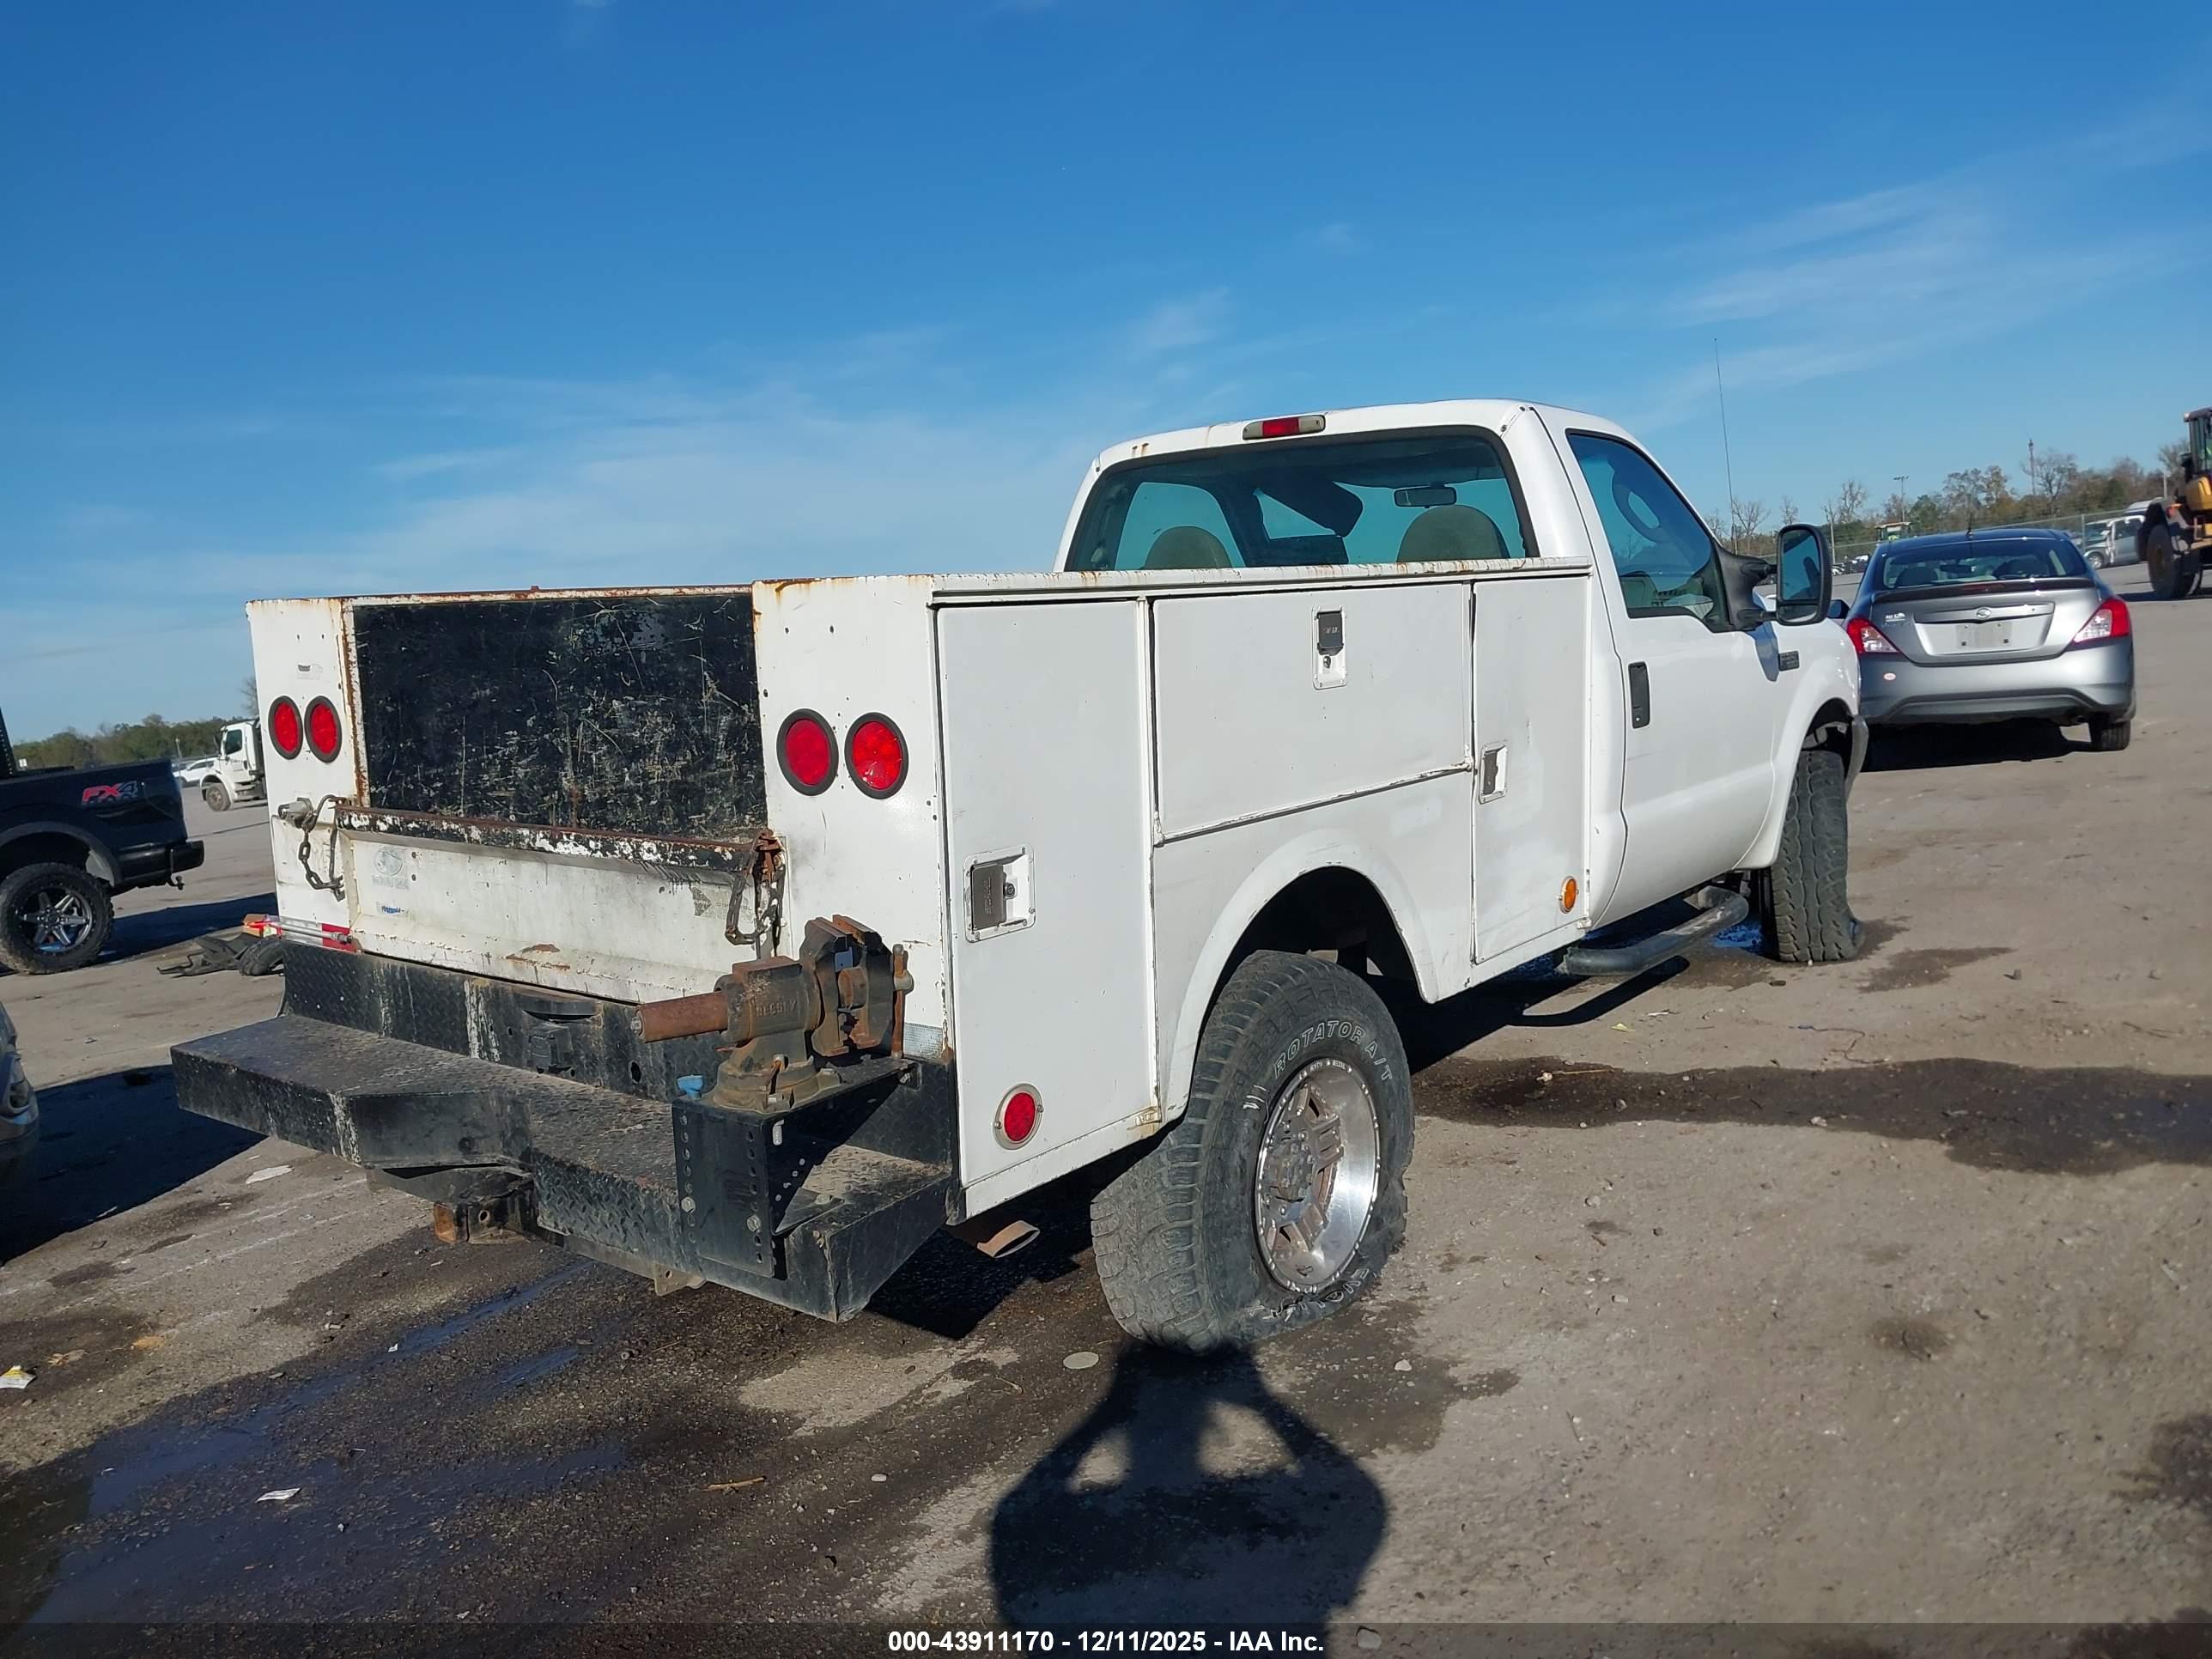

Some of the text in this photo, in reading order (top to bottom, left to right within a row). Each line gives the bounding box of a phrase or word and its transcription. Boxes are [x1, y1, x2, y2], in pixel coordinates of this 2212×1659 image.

[82, 781, 138, 803] FX4
[1273, 1020, 1393, 1081] ROTATOR A/T
